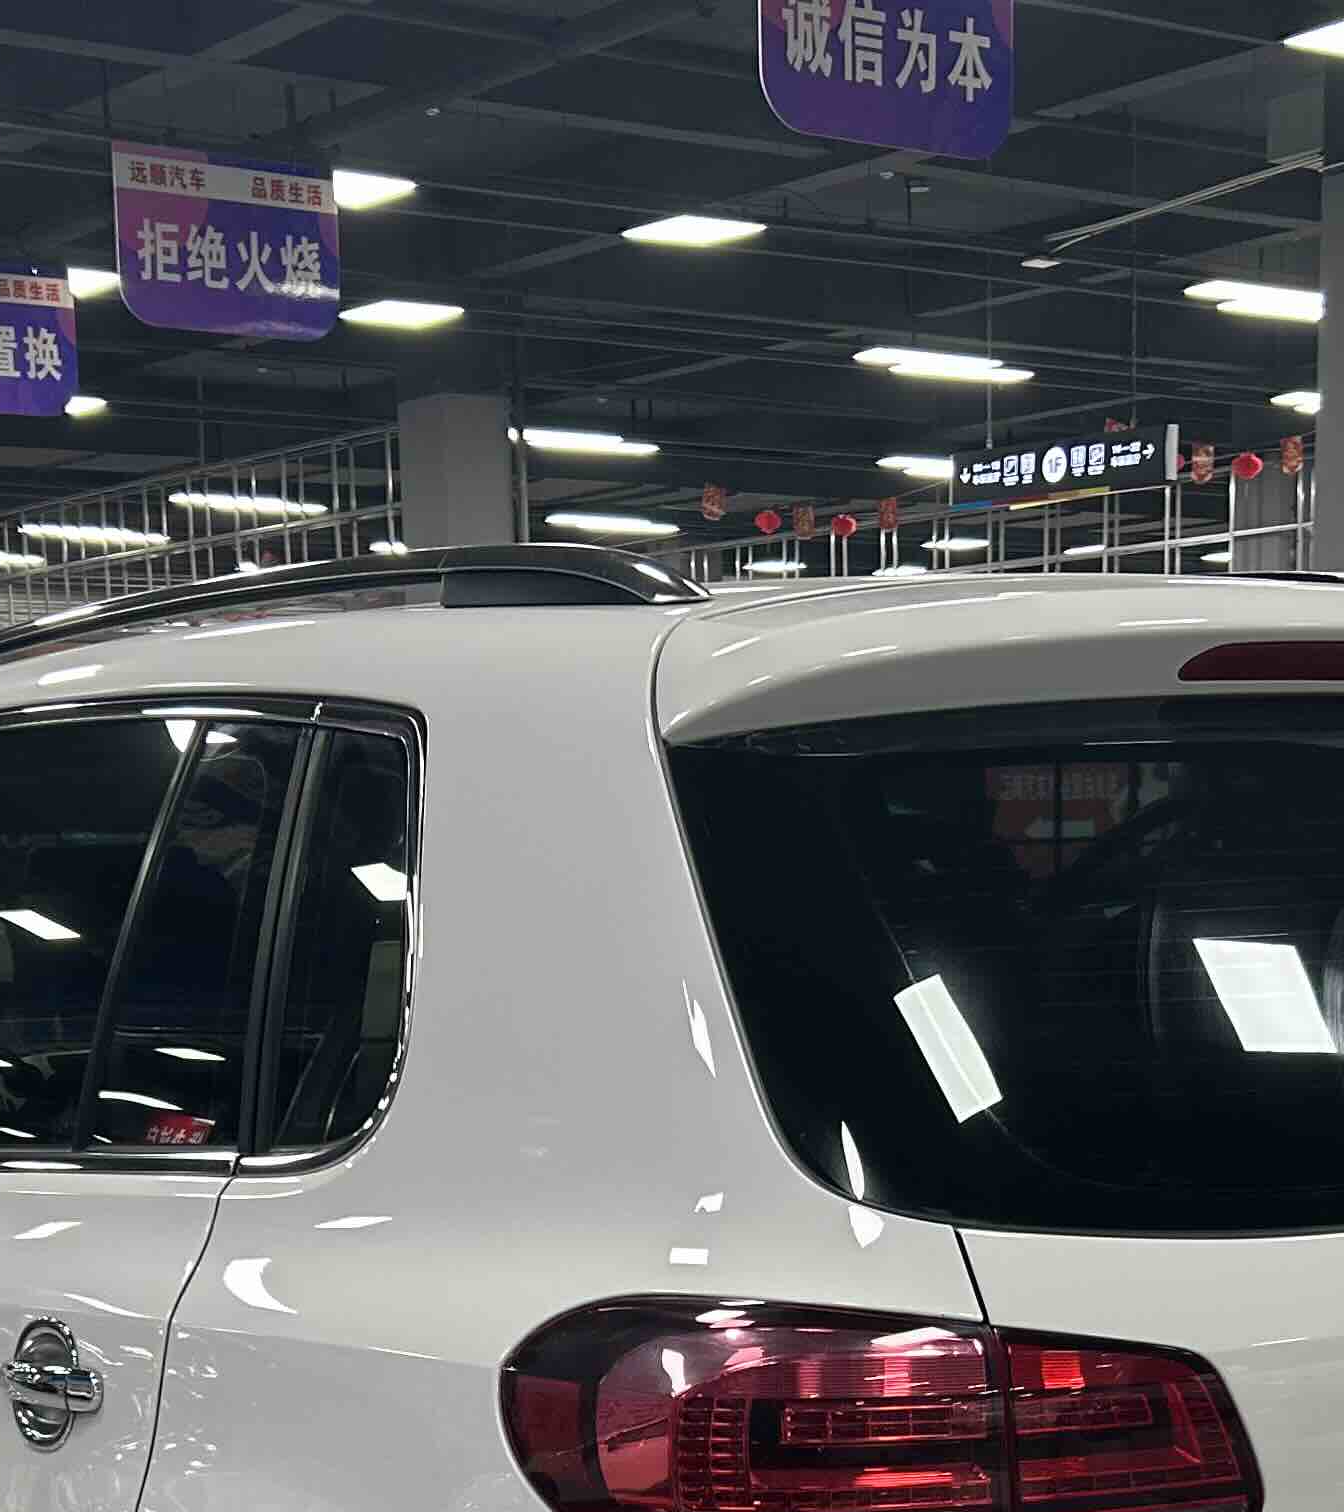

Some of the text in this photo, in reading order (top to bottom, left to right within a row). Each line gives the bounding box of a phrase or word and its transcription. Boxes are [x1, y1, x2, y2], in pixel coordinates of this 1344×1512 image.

[782, 0, 993, 103] 诚信为本
[128, 160, 322, 207] 远顺汽车 品质生活
[136, 217, 321, 295] 拒绝火烧
